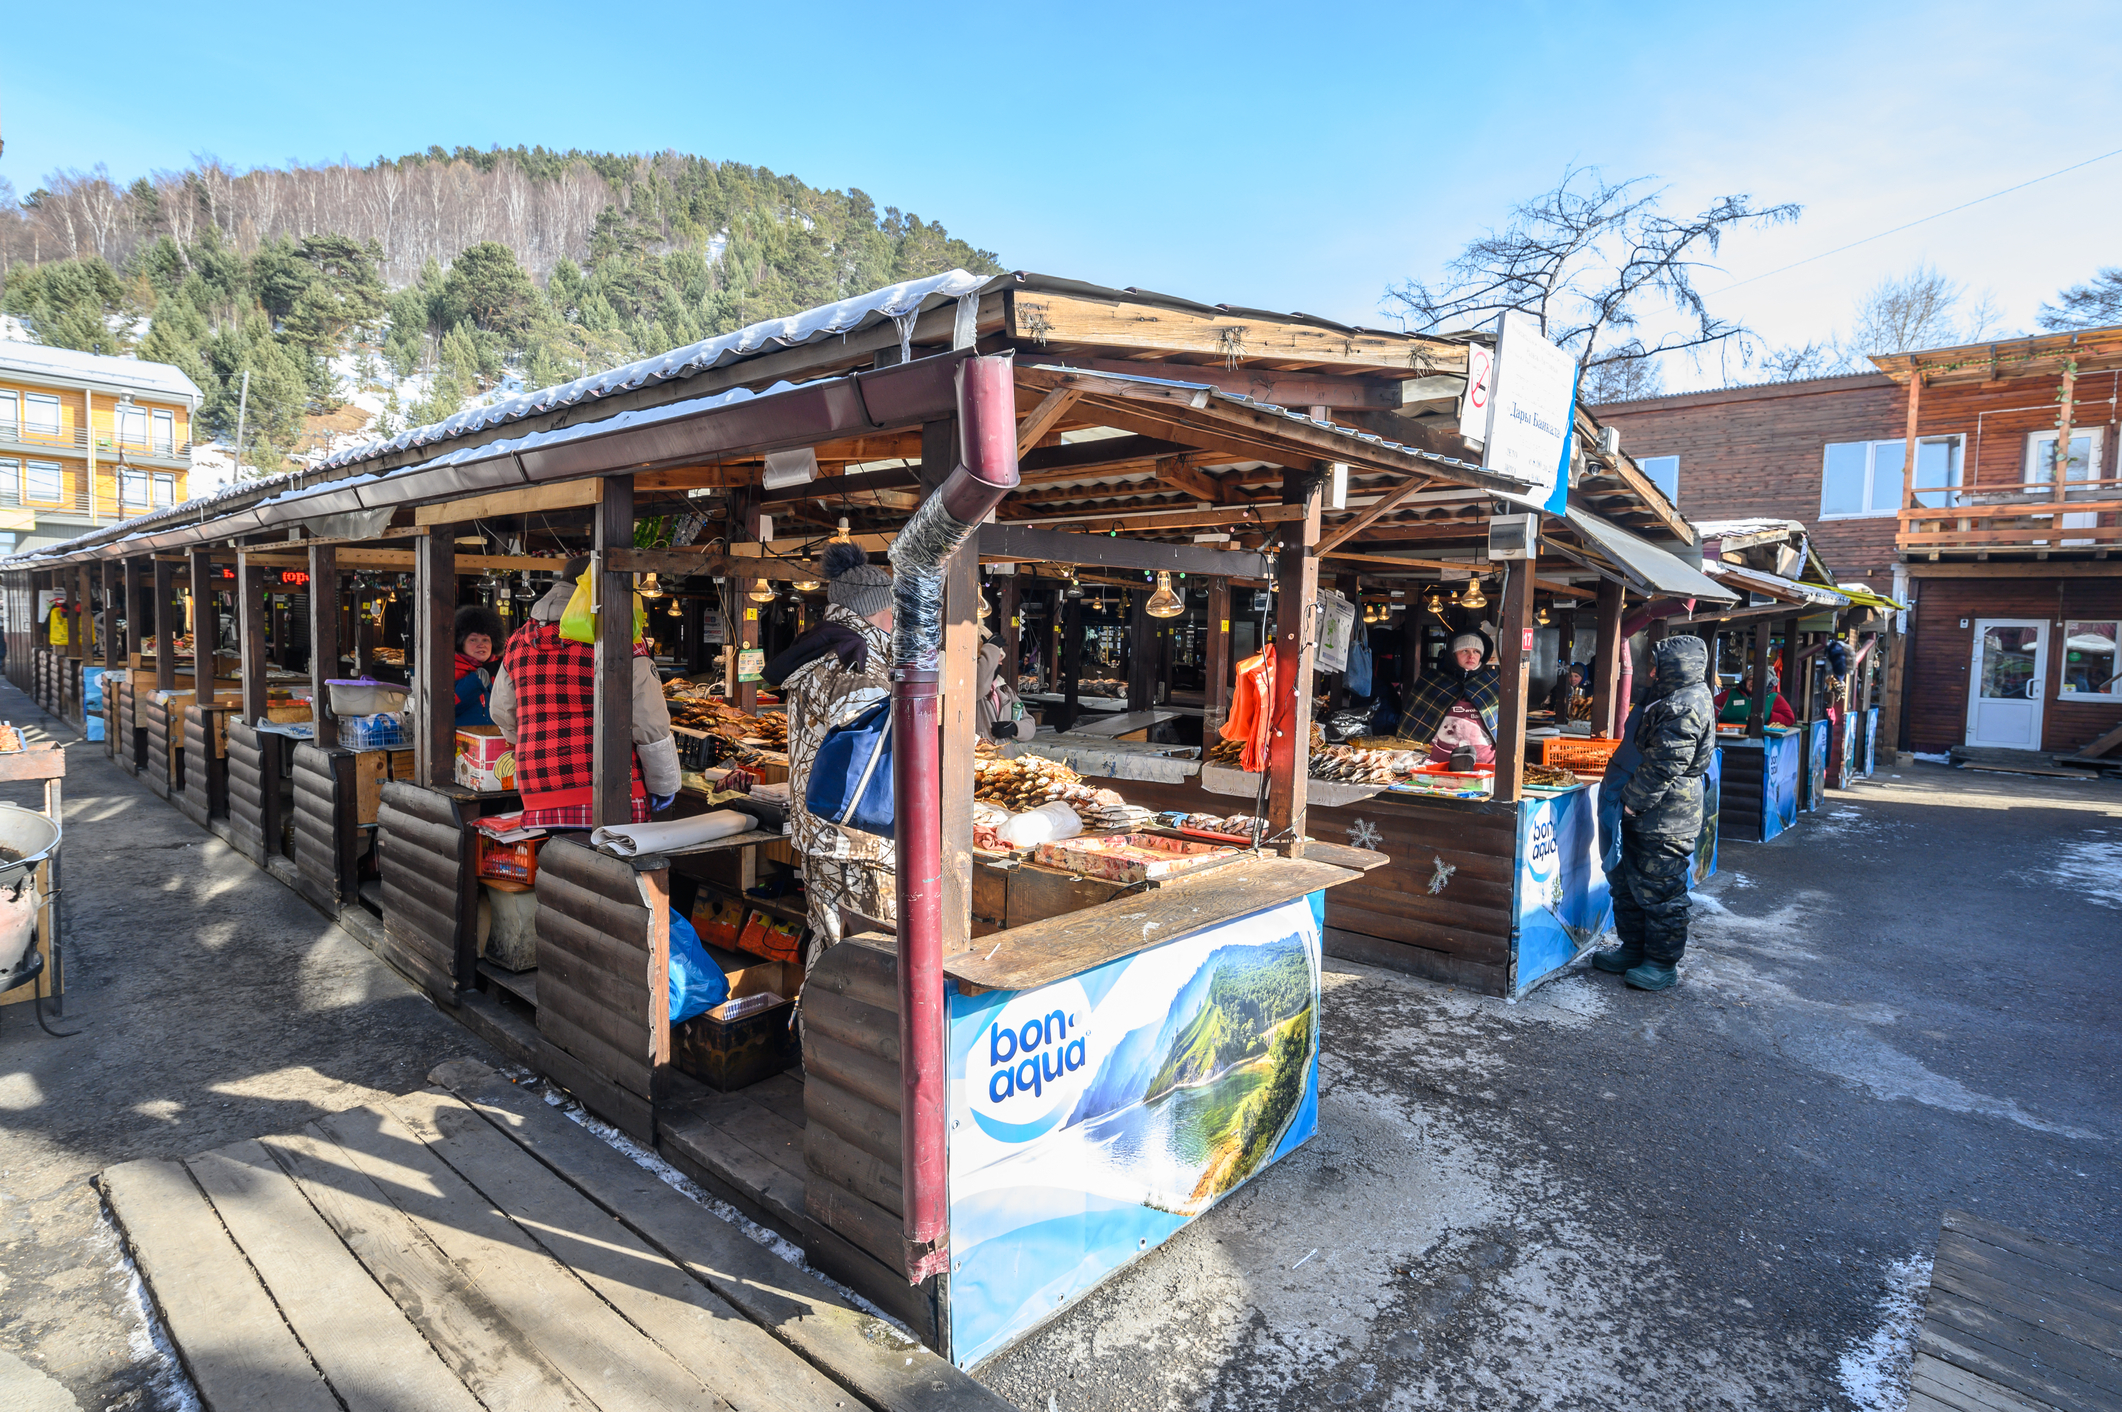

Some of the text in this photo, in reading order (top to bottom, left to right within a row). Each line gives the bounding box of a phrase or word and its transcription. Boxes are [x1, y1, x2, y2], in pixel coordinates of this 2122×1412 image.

[1524, 632, 1533, 647] 17
[1533, 820, 1554, 842] bon
[1532, 837, 1557, 862] aqua
[990, 1009, 1067, 1066] bon
[988, 1036, 1086, 1104] aqua
